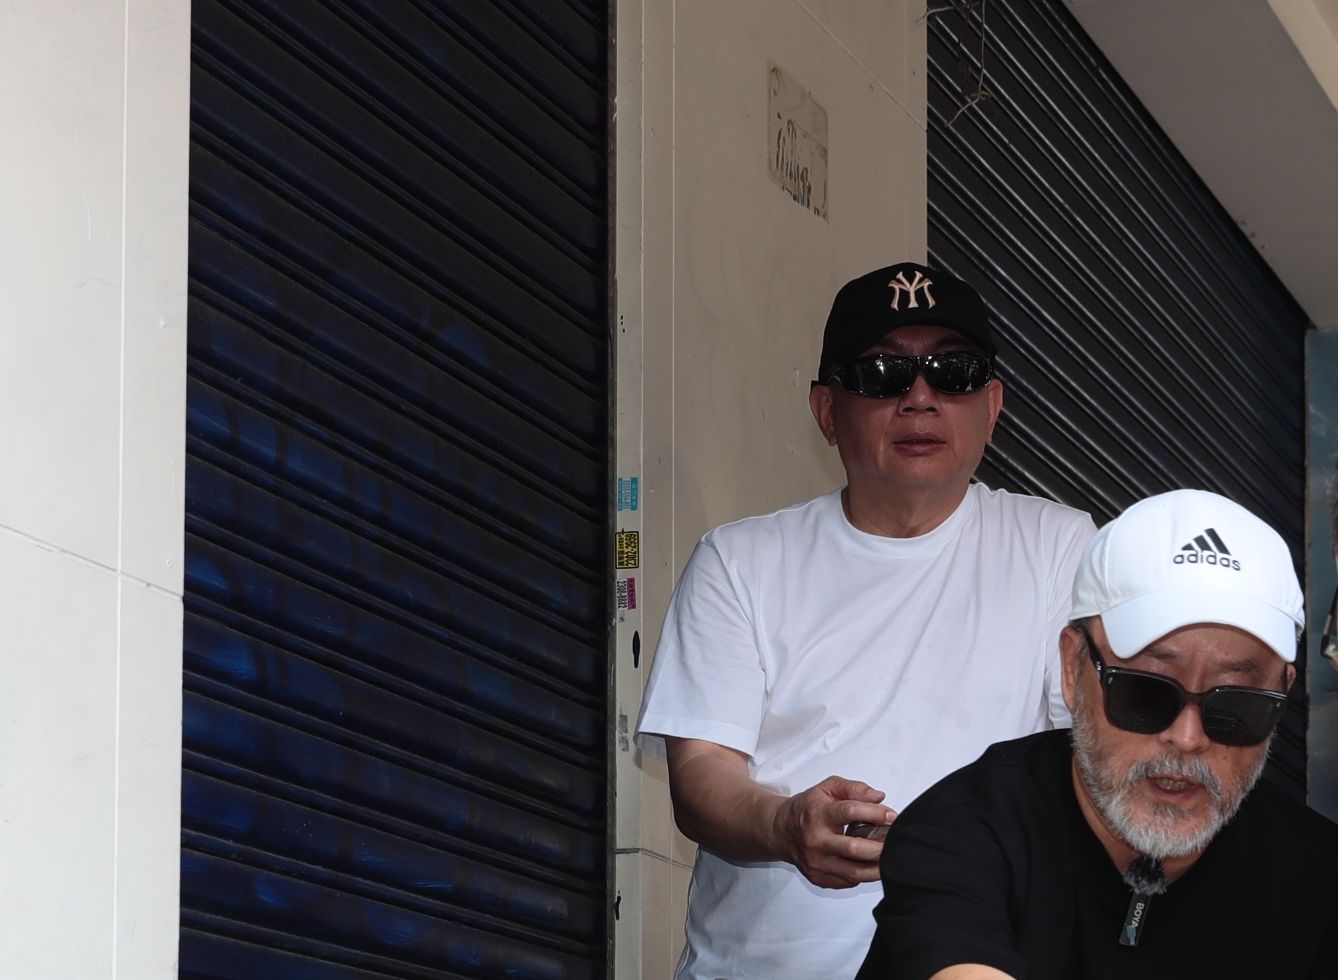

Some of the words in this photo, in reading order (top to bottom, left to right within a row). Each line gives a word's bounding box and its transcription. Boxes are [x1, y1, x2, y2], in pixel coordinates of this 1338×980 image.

[888, 270, 936, 311] NY
[1173, 549, 1241, 571] adidas
[1131, 902, 1145, 929] BOYA
